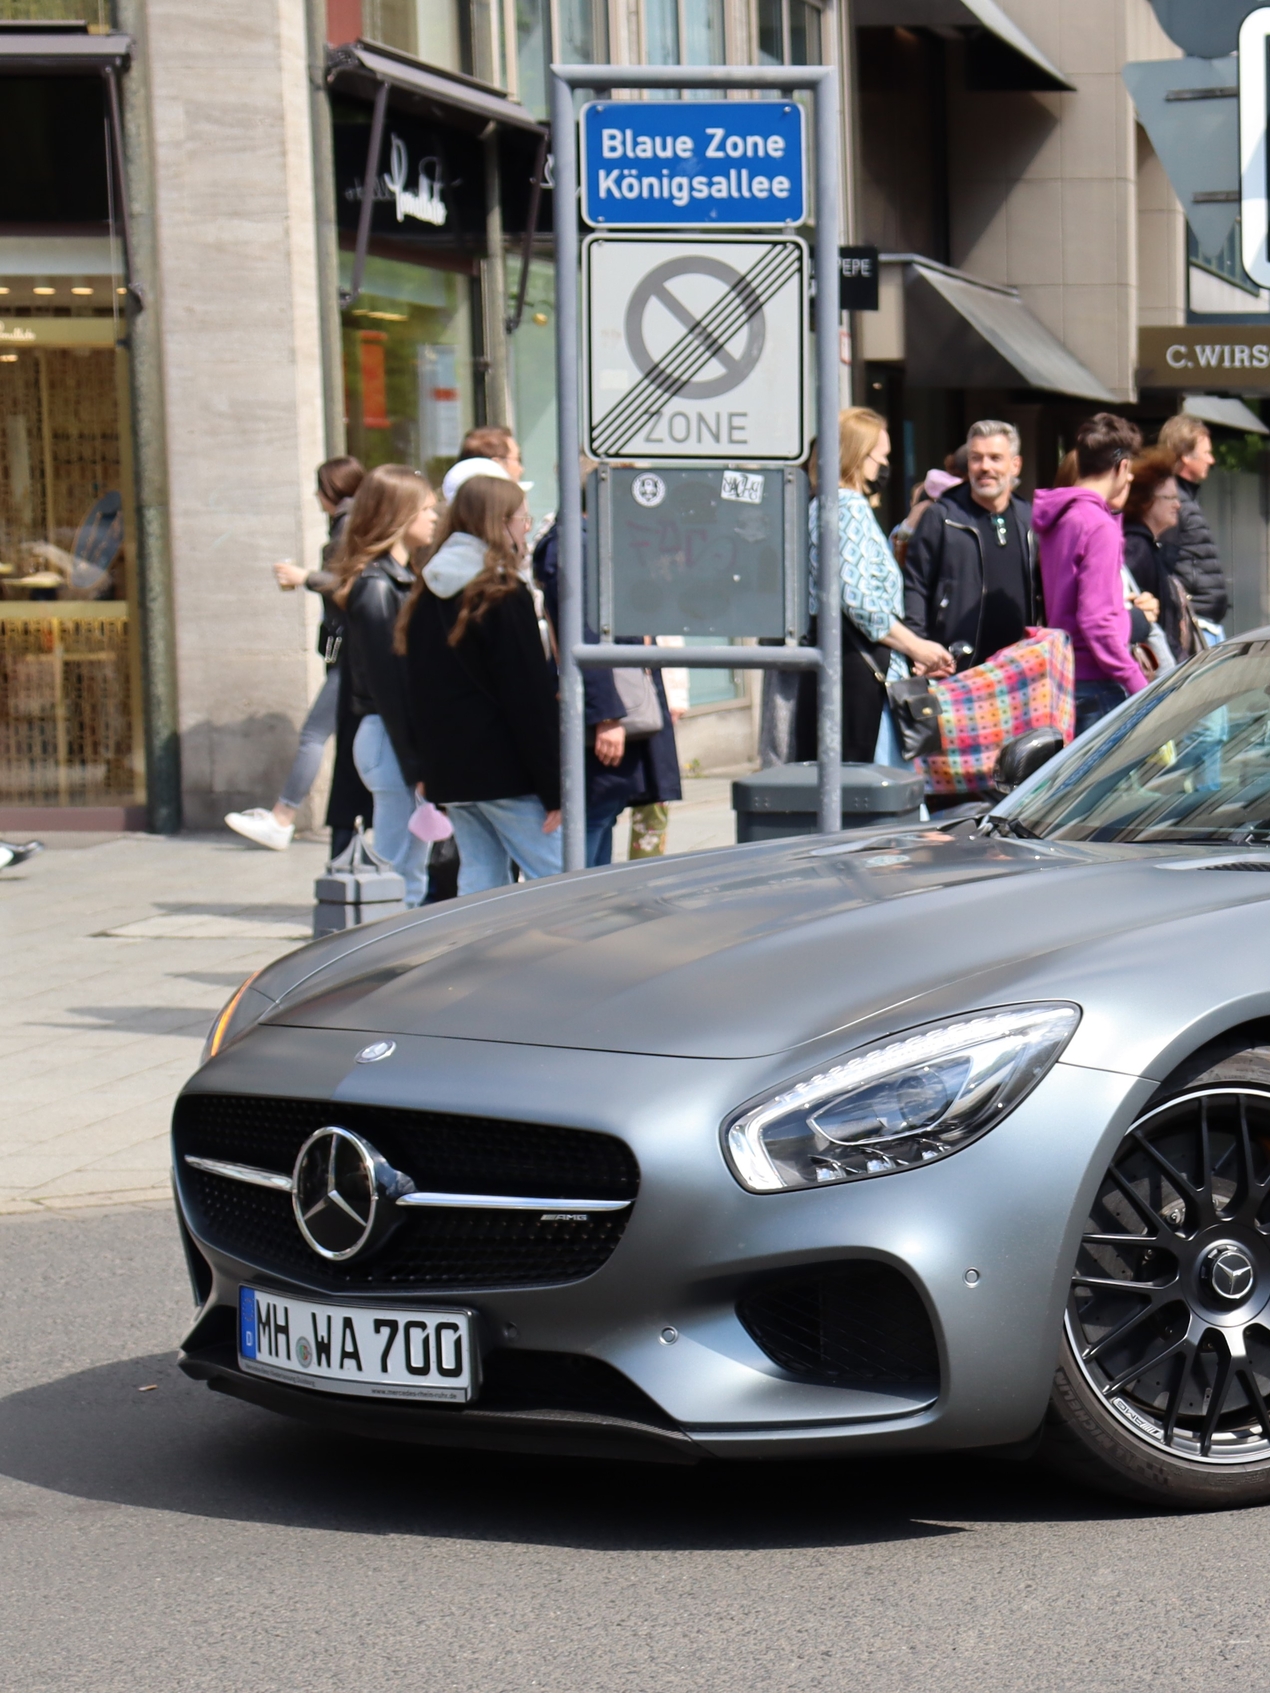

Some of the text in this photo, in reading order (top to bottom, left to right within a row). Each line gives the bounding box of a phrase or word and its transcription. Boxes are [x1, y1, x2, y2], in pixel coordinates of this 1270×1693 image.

[601, 128, 786, 159] Blaue Zone
[598, 168, 791, 207] Königsallee
[643, 411, 748, 444] ZONE
[256, 1299, 463, 1378] MH WA 700
[1116, 1400, 1144, 1426] AMG
